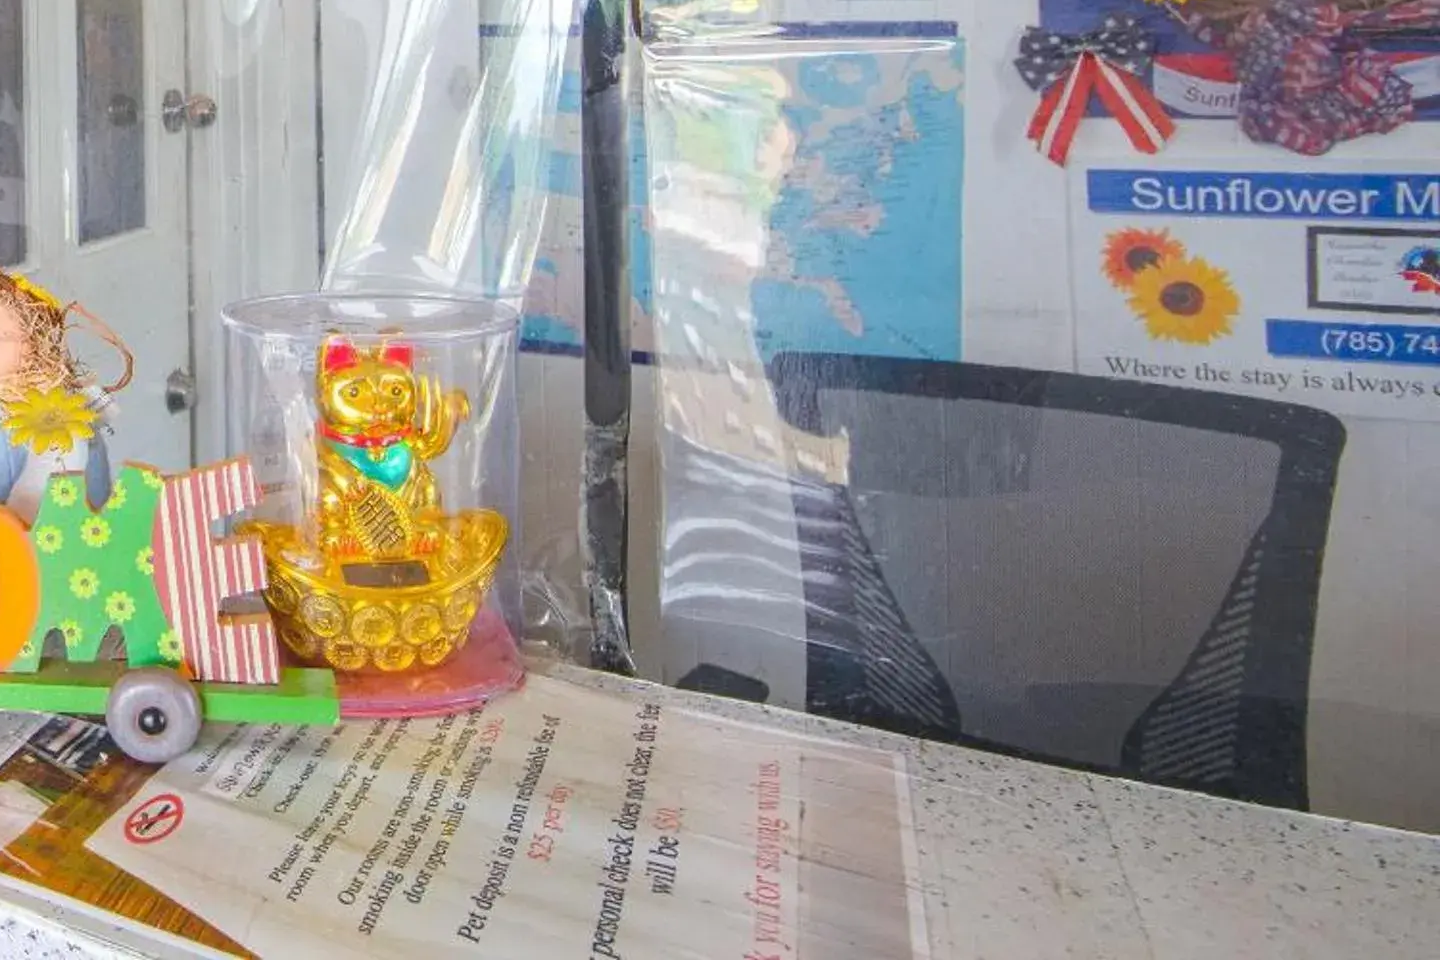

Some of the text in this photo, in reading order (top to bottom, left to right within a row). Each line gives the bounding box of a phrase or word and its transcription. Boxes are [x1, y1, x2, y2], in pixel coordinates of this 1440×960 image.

[1130, 176, 1379, 216] Sunflower
[1318, 328, 1440, 357] (785) 74
[1102, 355, 1187, 384] Where
[1193, 362, 1232, 384] the
[1240, 365, 1293, 393] stay
[1301, 368, 1324, 388] is
[1330, 370, 1425, 402] always
[633, 723, 658, 747] the
[514, 743, 551, 803] refundable
[628, 745, 654, 782] clear,
[622, 778, 644, 803] not
[751, 781, 780, 813] with
[270, 841, 306, 885] Please
[295, 815, 323, 842] leave
[320, 791, 343, 818] your
[508, 800, 530, 838] non
[525, 830, 553, 864] $25
[543, 807, 563, 835] per
[609, 799, 640, 836] does
[287, 866, 316, 904] room
[309, 834, 337, 868] when
[331, 811, 351, 837] you
[346, 773, 379, 811] depart,
[358, 870, 404, 937] smoking
[389, 834, 422, 869] inside
[413, 812, 432, 840] the
[423, 778, 448, 815] room
[405, 863, 436, 906] door
[427, 834, 450, 868] open
[441, 798, 468, 839] while
[494, 839, 516, 860] is
[507, 832, 520, 847] a
[602, 831, 635, 884] check
[647, 833, 681, 860] be
[754, 817, 789, 875] staying
[337, 879, 363, 907] Our
[360, 837, 389, 878] rooms
[383, 818, 399, 840] are
[472, 852, 510, 914] deposit
[646, 857, 677, 898] will
[747, 873, 782, 903] for
[456, 910, 485, 945] Pet
[591, 878, 626, 960] personal
[752, 902, 788, 954] you
